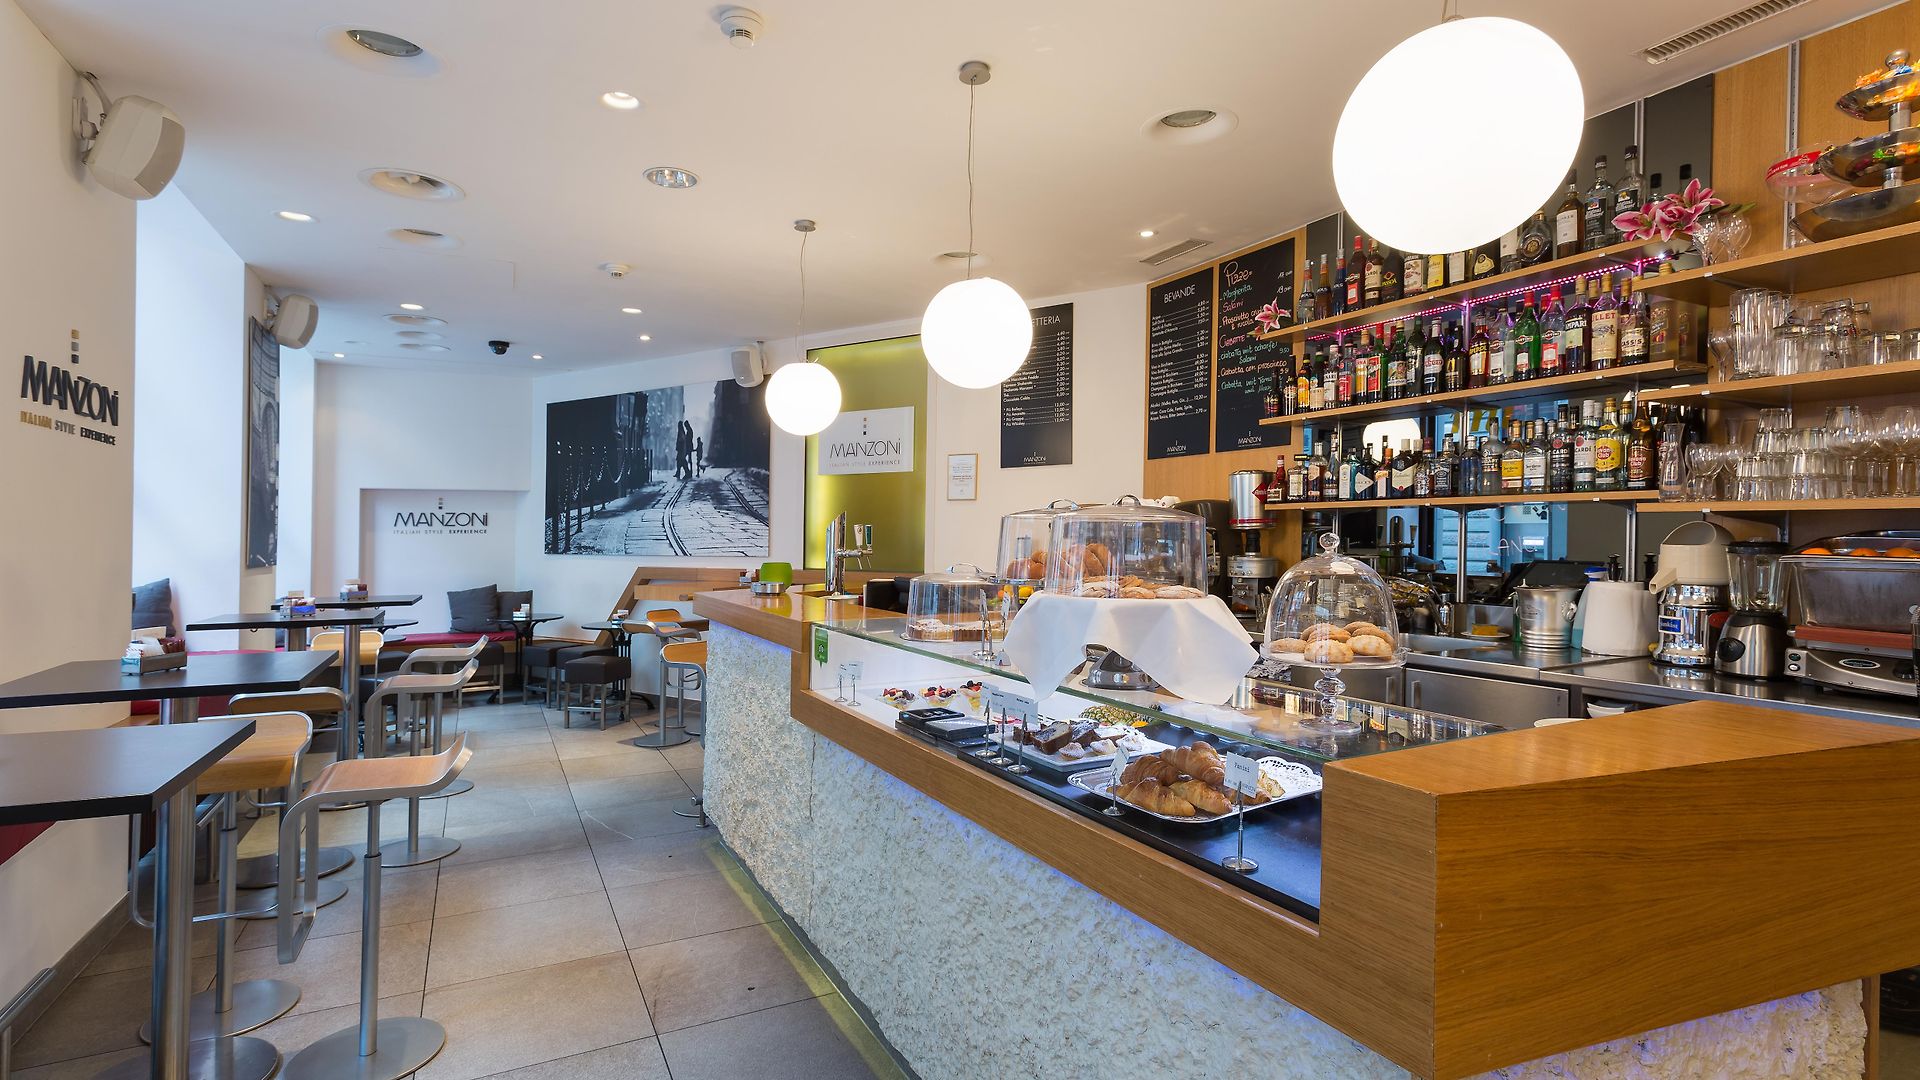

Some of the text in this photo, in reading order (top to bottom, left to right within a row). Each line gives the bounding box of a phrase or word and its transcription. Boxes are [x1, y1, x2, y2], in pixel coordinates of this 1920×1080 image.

[1163, 284, 1196, 304] BEVANDE
[1222, 298, 1244, 313] Salami
[1239, 354, 1256, 364] Salami
[54, 420, 76, 435] STYLE
[80, 426, 116, 446] EXPERIENCE
